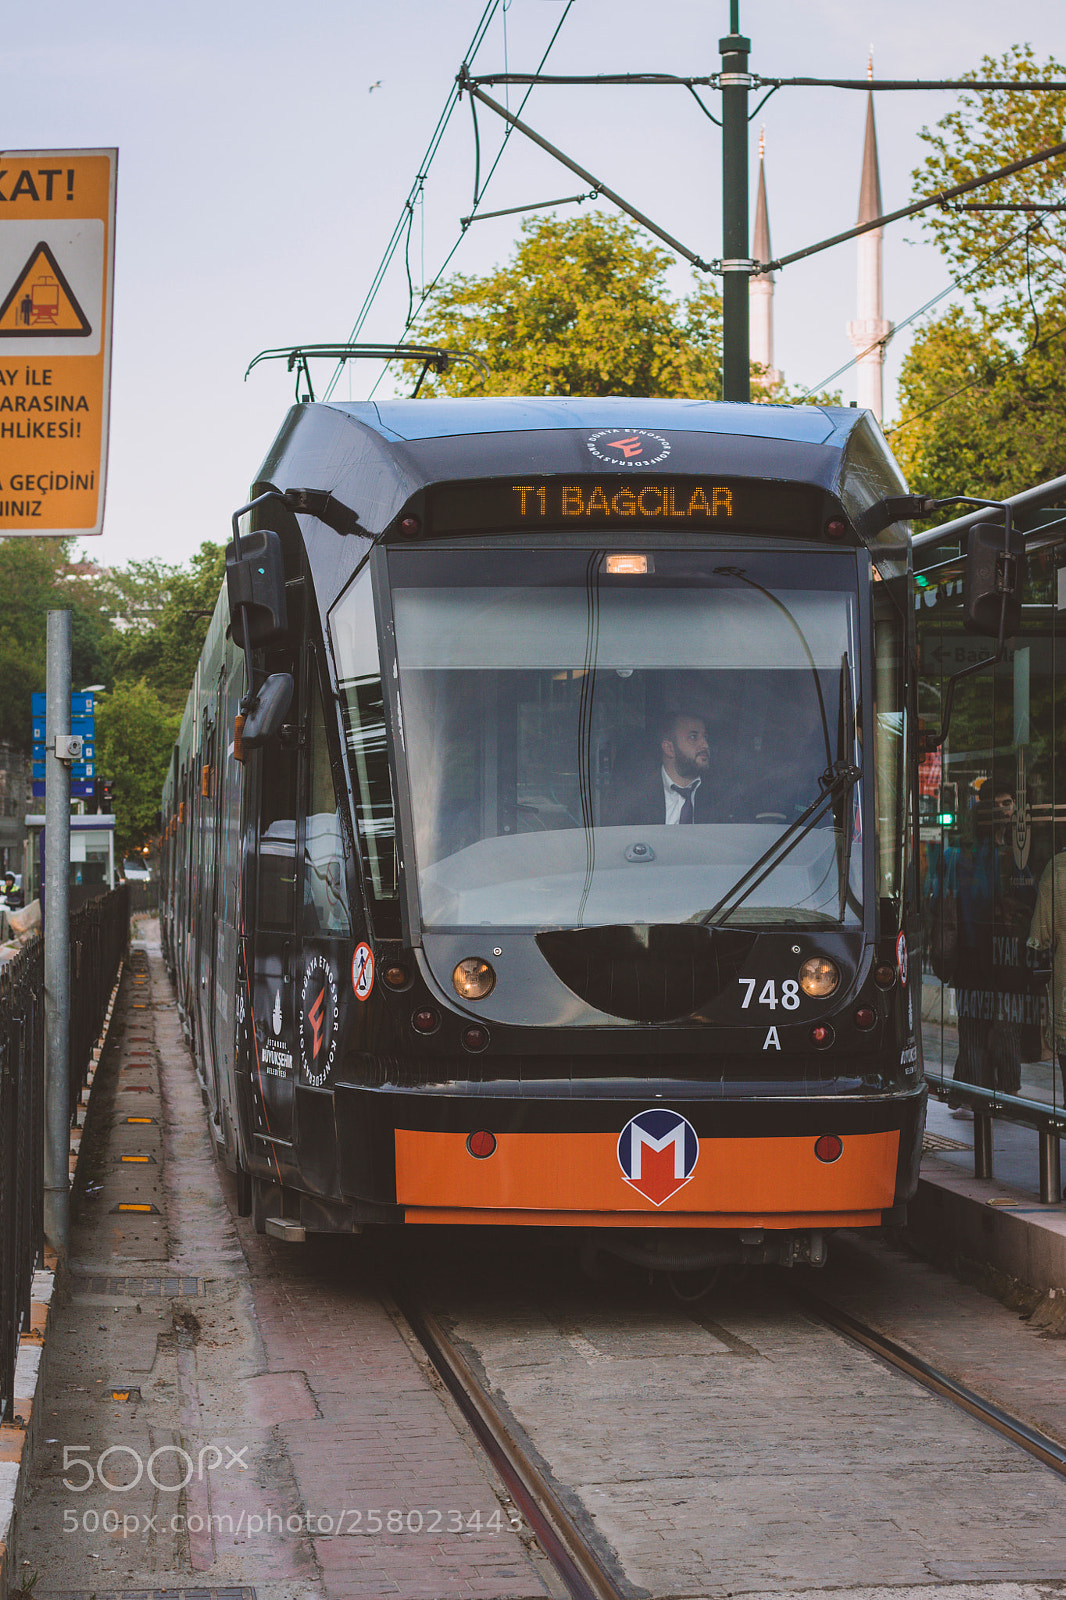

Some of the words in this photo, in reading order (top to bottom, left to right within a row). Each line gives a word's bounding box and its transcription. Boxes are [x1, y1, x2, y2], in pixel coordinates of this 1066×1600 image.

[26, 365, 53, 386] İLE
[0, 395, 90, 412] ARASINA
[10, 470, 95, 495] GEÇİDİNİ
[512, 486, 546, 516] T1
[738, 978, 800, 1010] 748
[762, 1026, 782, 1050] A
